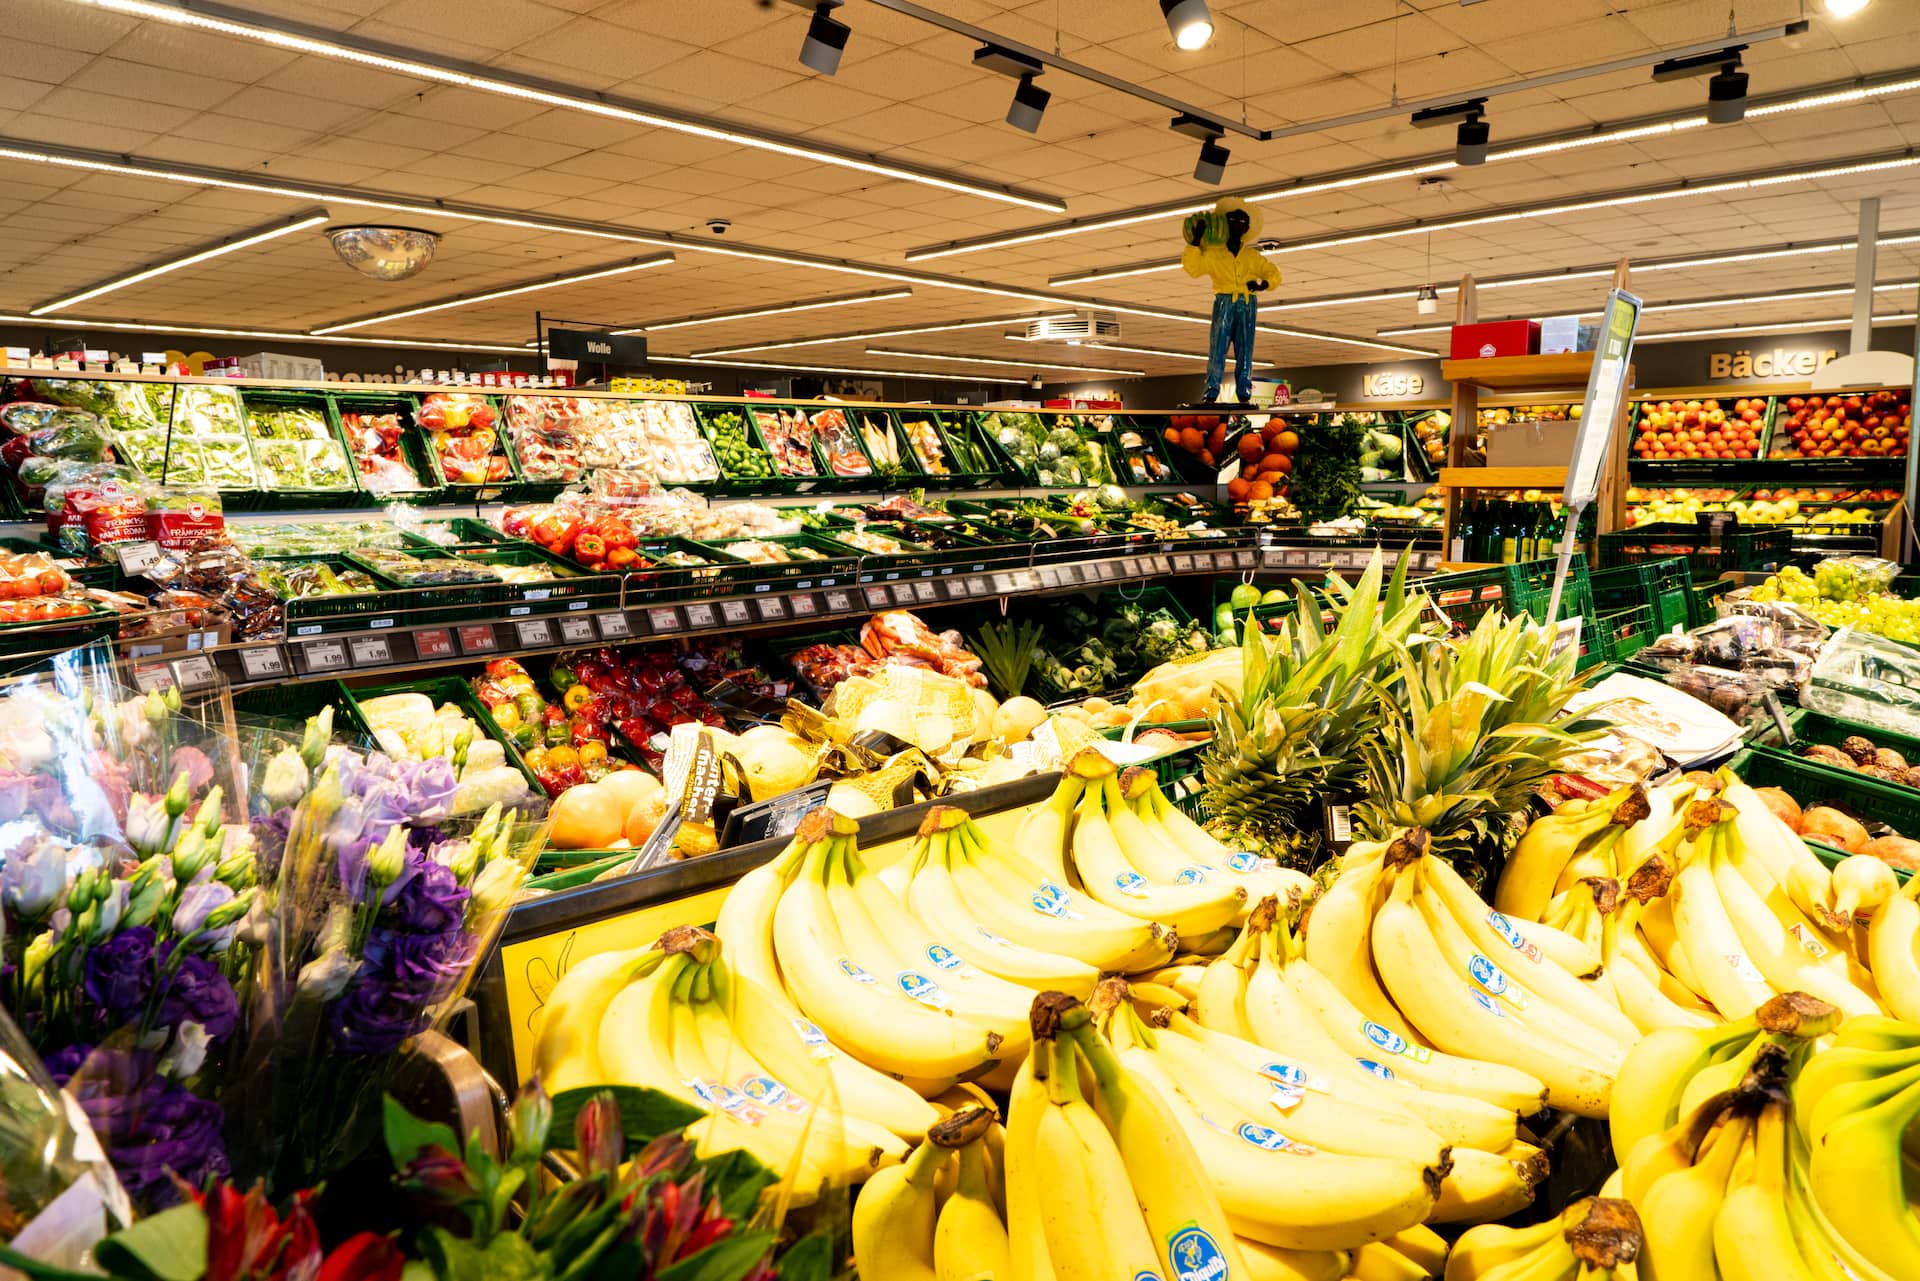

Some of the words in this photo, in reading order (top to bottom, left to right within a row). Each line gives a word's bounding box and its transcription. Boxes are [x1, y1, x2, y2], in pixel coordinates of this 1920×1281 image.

[587, 340, 612, 355] Wolle
[1709, 348, 1838, 379] Bäcker
[1362, 371, 1424, 397] Käse
[323, 654, 342, 664] 1.99
[368, 649, 387, 659] 1.99
[261, 661, 281, 671] 1.99
